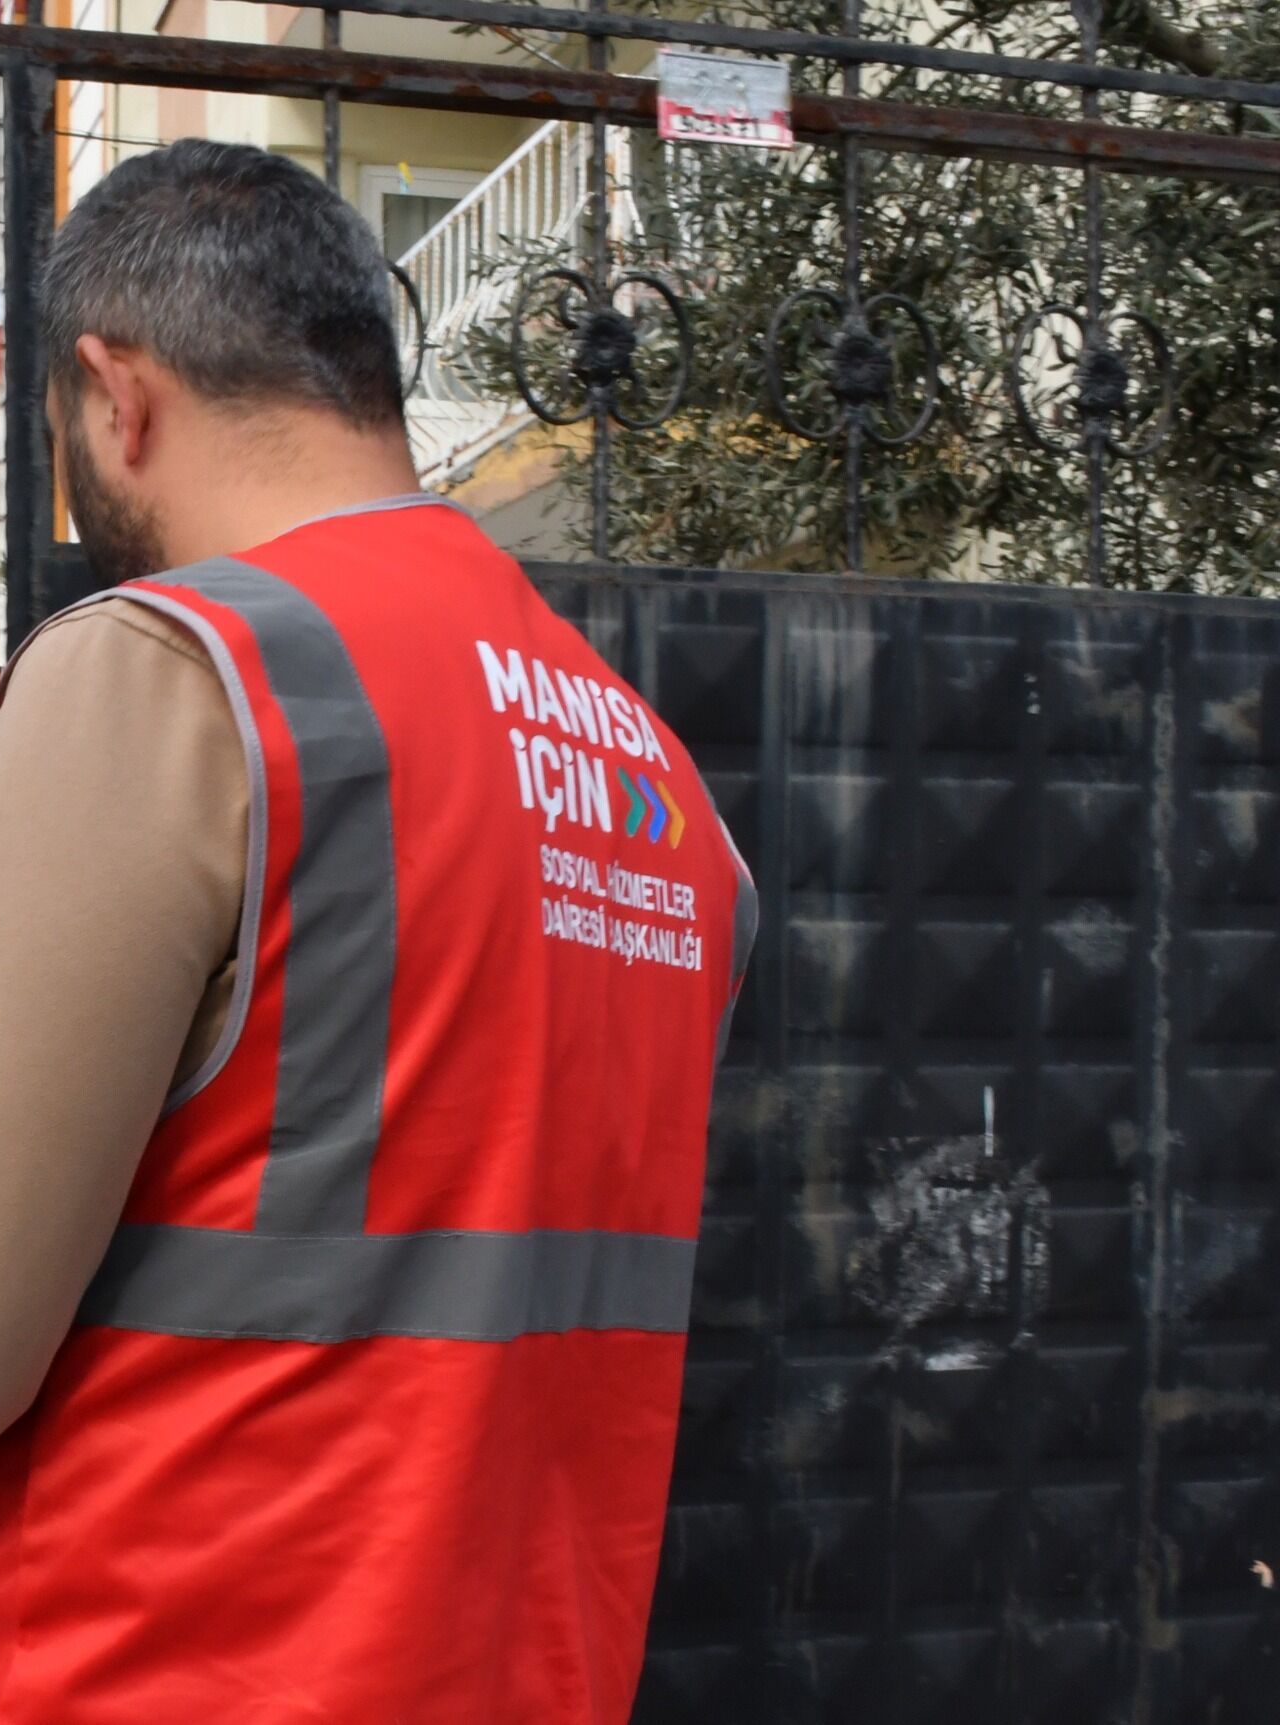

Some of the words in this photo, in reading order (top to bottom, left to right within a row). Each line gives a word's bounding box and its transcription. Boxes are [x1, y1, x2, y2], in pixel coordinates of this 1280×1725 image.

[540, 843, 608, 897] SOSYAL
[607, 859, 696, 921] HİZMETLER
[541, 894, 607, 948] DAİRESİ
